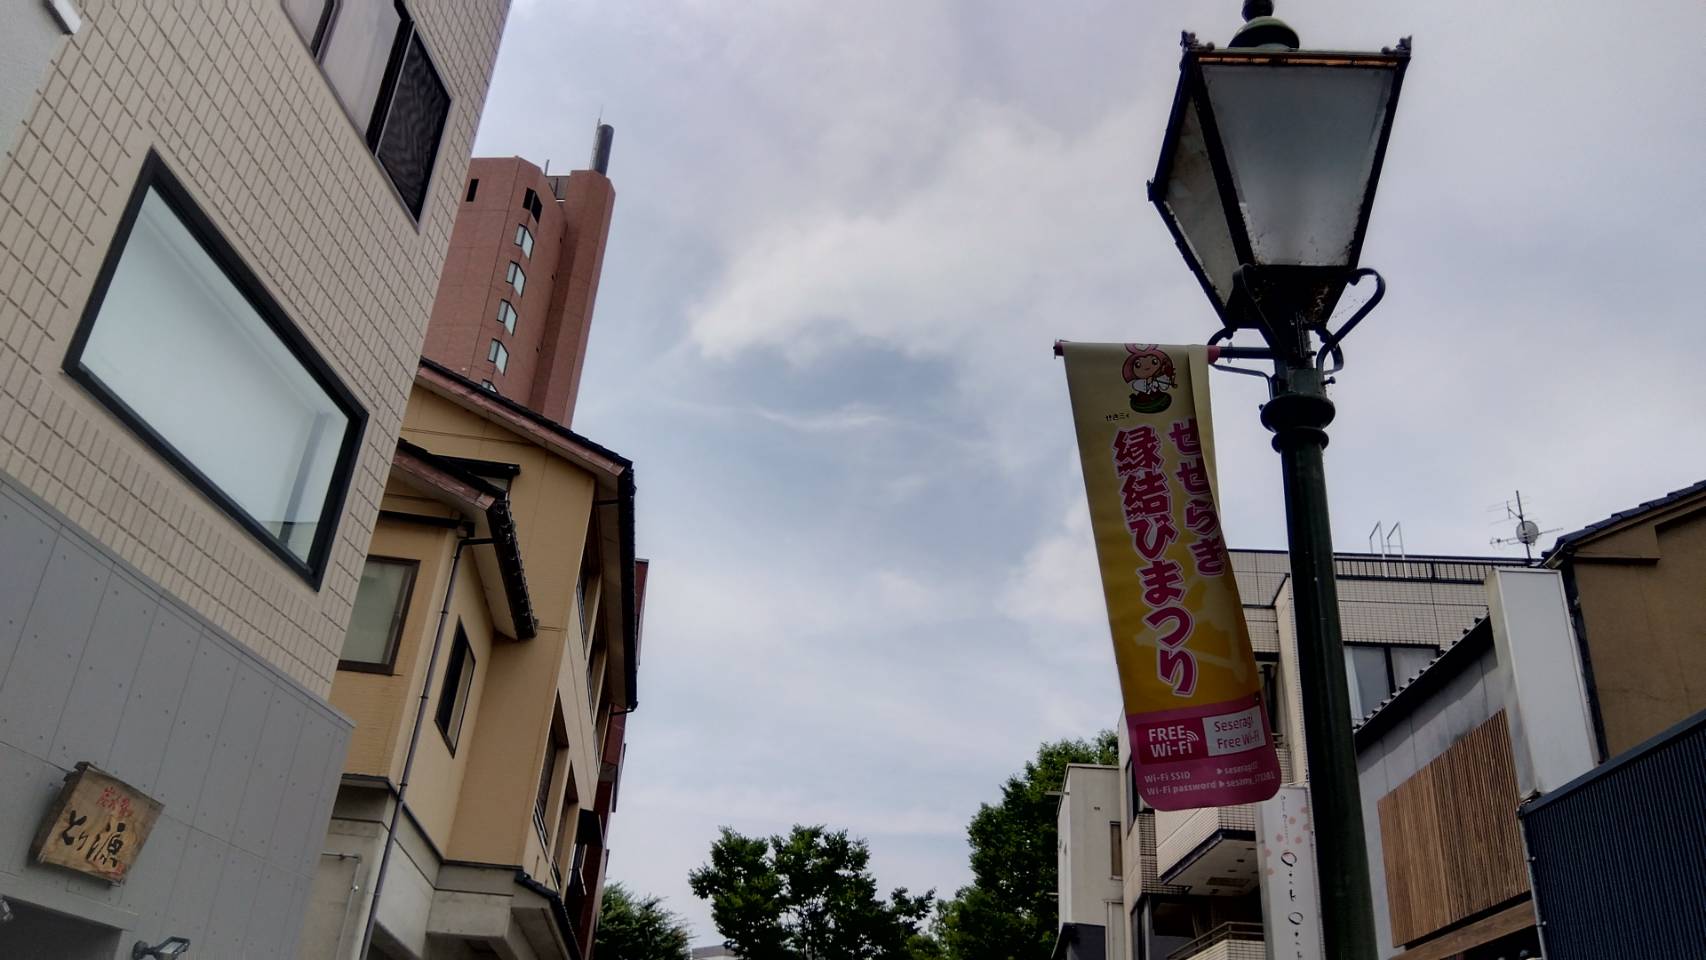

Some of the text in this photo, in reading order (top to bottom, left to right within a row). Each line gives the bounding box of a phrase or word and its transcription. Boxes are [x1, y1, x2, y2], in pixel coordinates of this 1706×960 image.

[1111, 425, 1199, 698] 縁結びまつり
[1148, 725, 1186, 743] FREE
[1150, 740, 1193, 758] Wi-Fi
[1217, 736, 1242, 751] Free
[1144, 770, 1191, 784] Wi-Fi SSID
[1147, 785, 1171, 796] Wi-Fi
[1173, 780, 1217, 794] password
